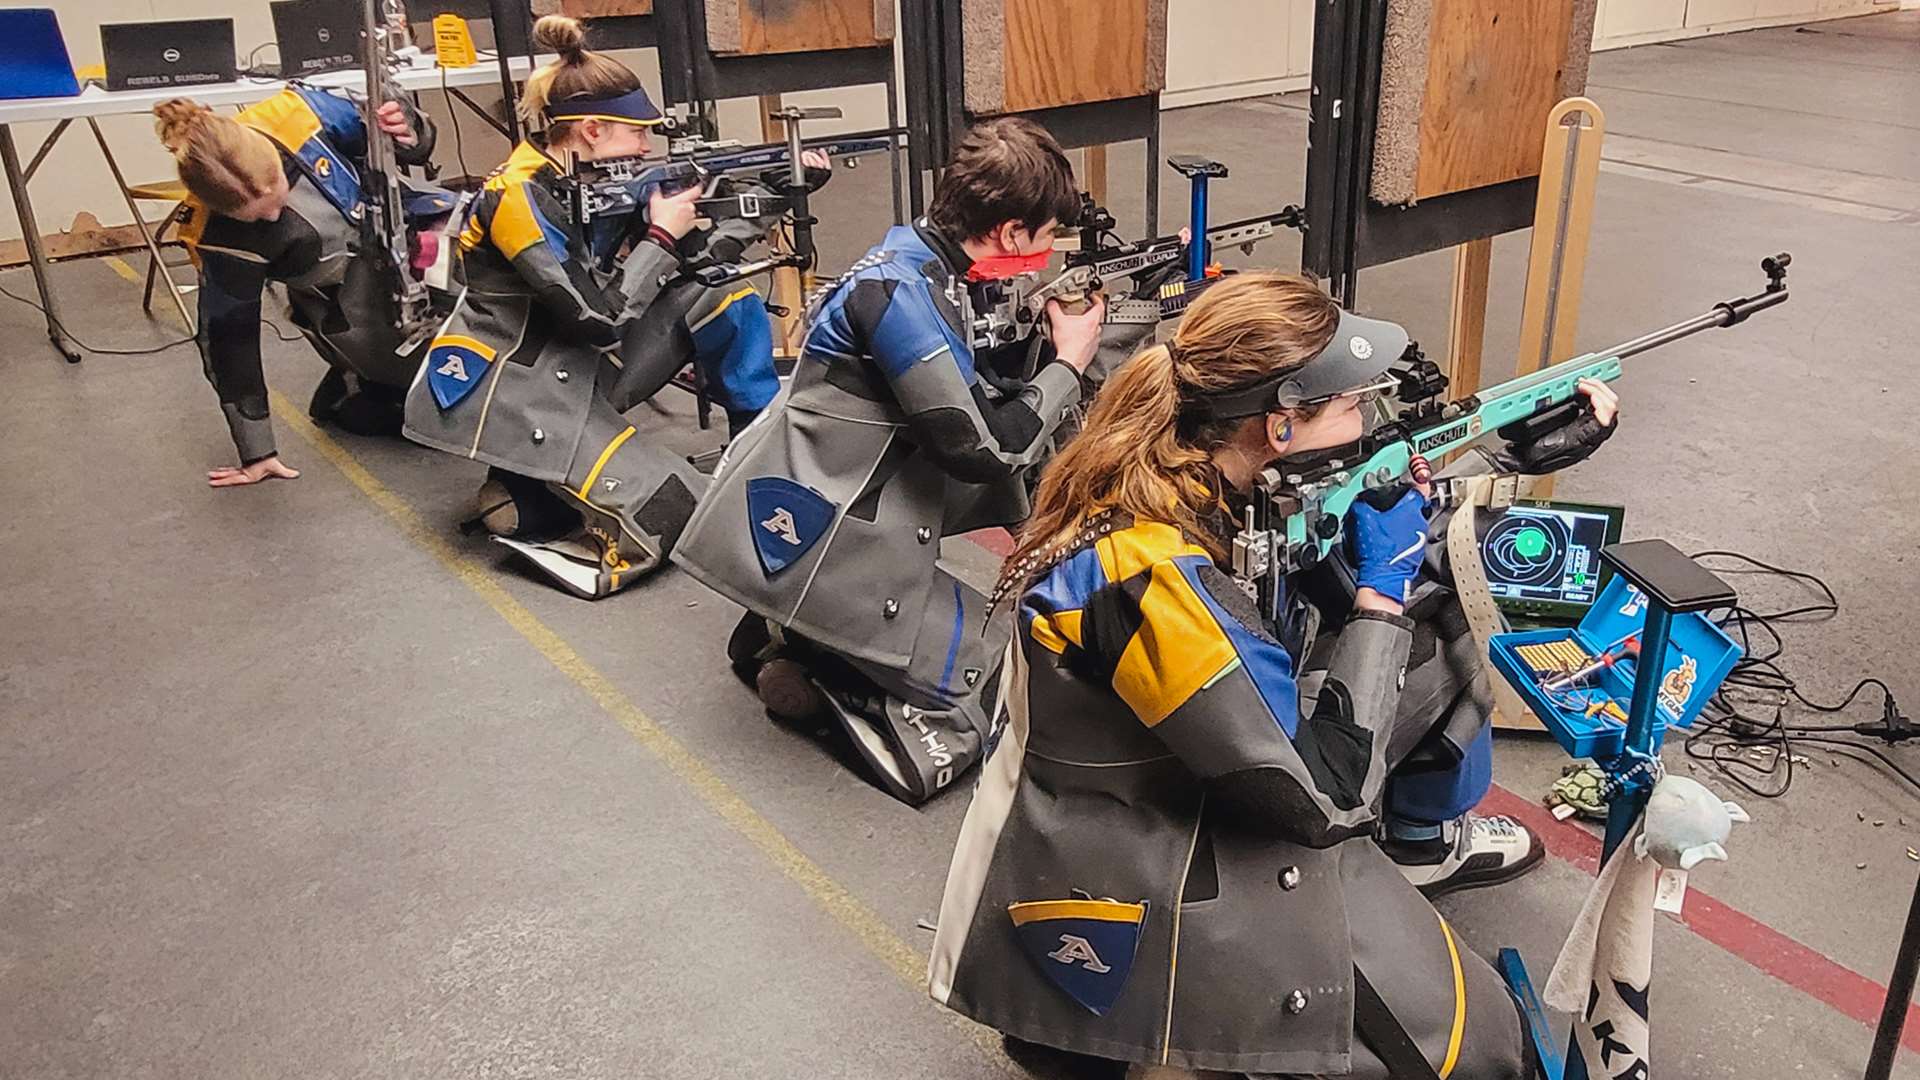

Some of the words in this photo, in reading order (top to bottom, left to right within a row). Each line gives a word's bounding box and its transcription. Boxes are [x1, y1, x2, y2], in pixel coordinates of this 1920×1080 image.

[436, 354, 470, 381] A
[760, 507, 802, 545] A
[1048, 933, 1111, 974] A
